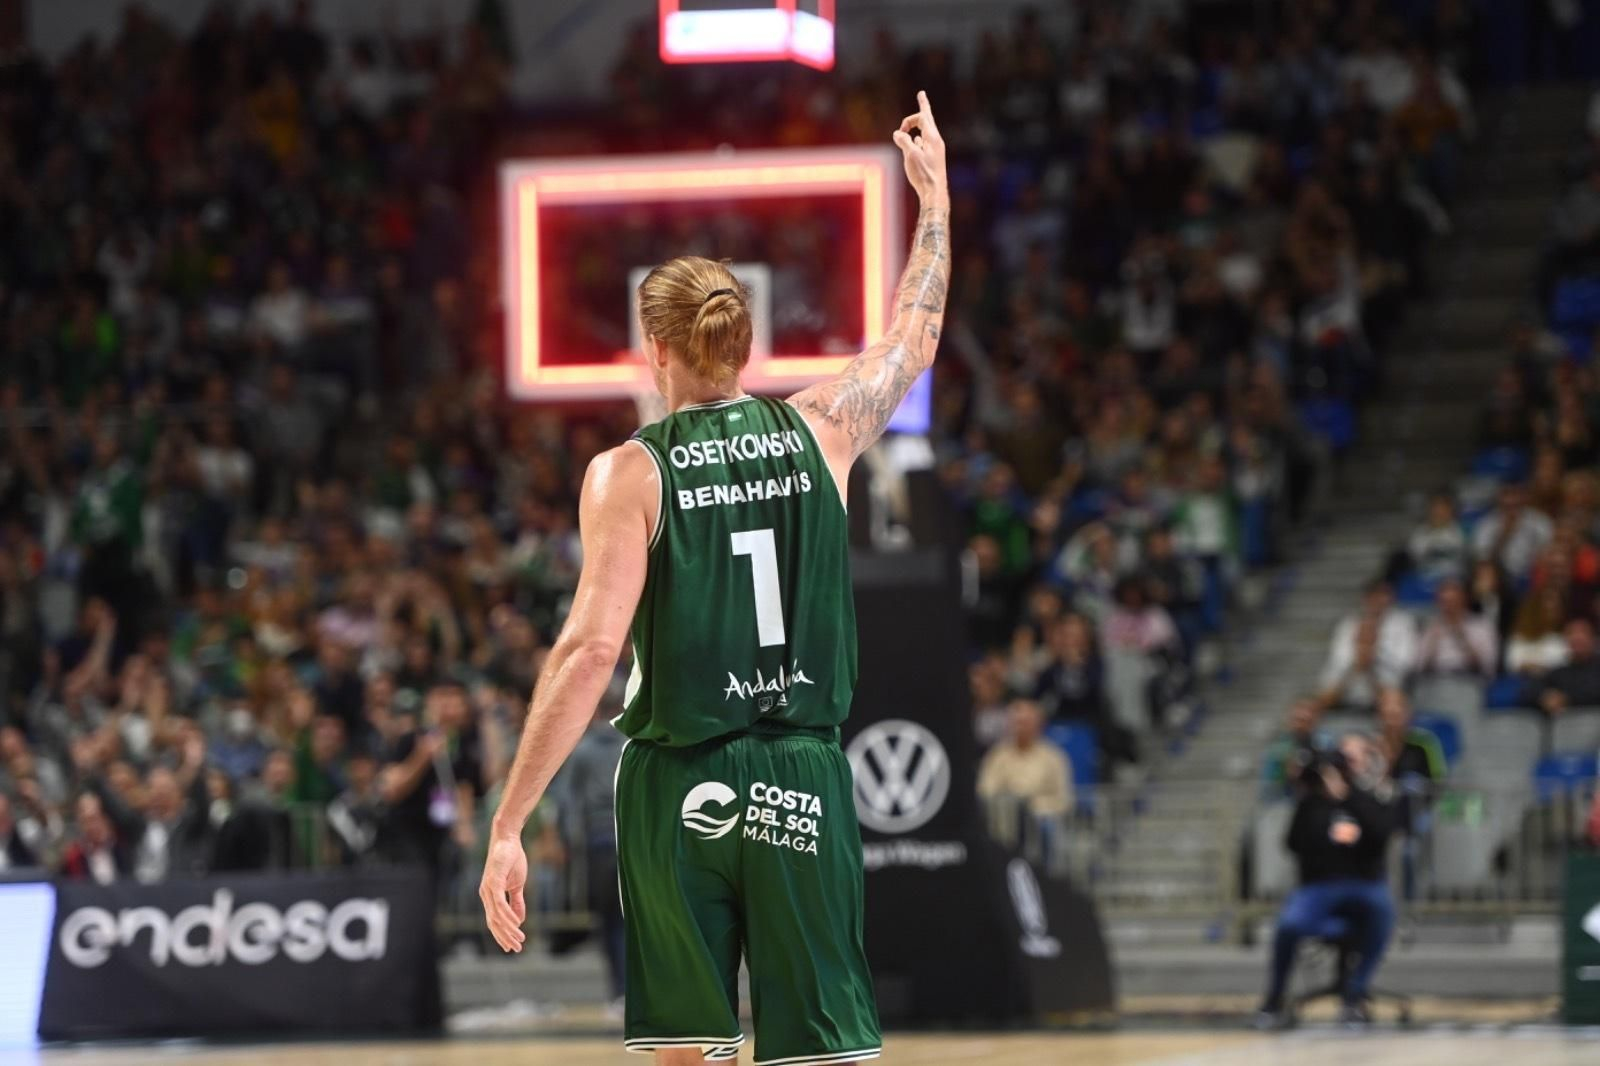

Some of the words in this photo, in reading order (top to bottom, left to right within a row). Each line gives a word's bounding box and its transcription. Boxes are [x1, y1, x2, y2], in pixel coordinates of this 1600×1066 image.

[670, 430, 804, 469] OSETKOWSKI
[678, 469, 811, 510] BENAHAVÍS
[730, 528, 786, 647] 1
[723, 658, 815, 701] Andalía
[750, 782, 822, 817] COSTA
[743, 825, 818, 856] MÁLAGA
[745, 805, 781, 827] DEL
[784, 814, 819, 837] SOL
[60, 888, 389, 967] endesa
